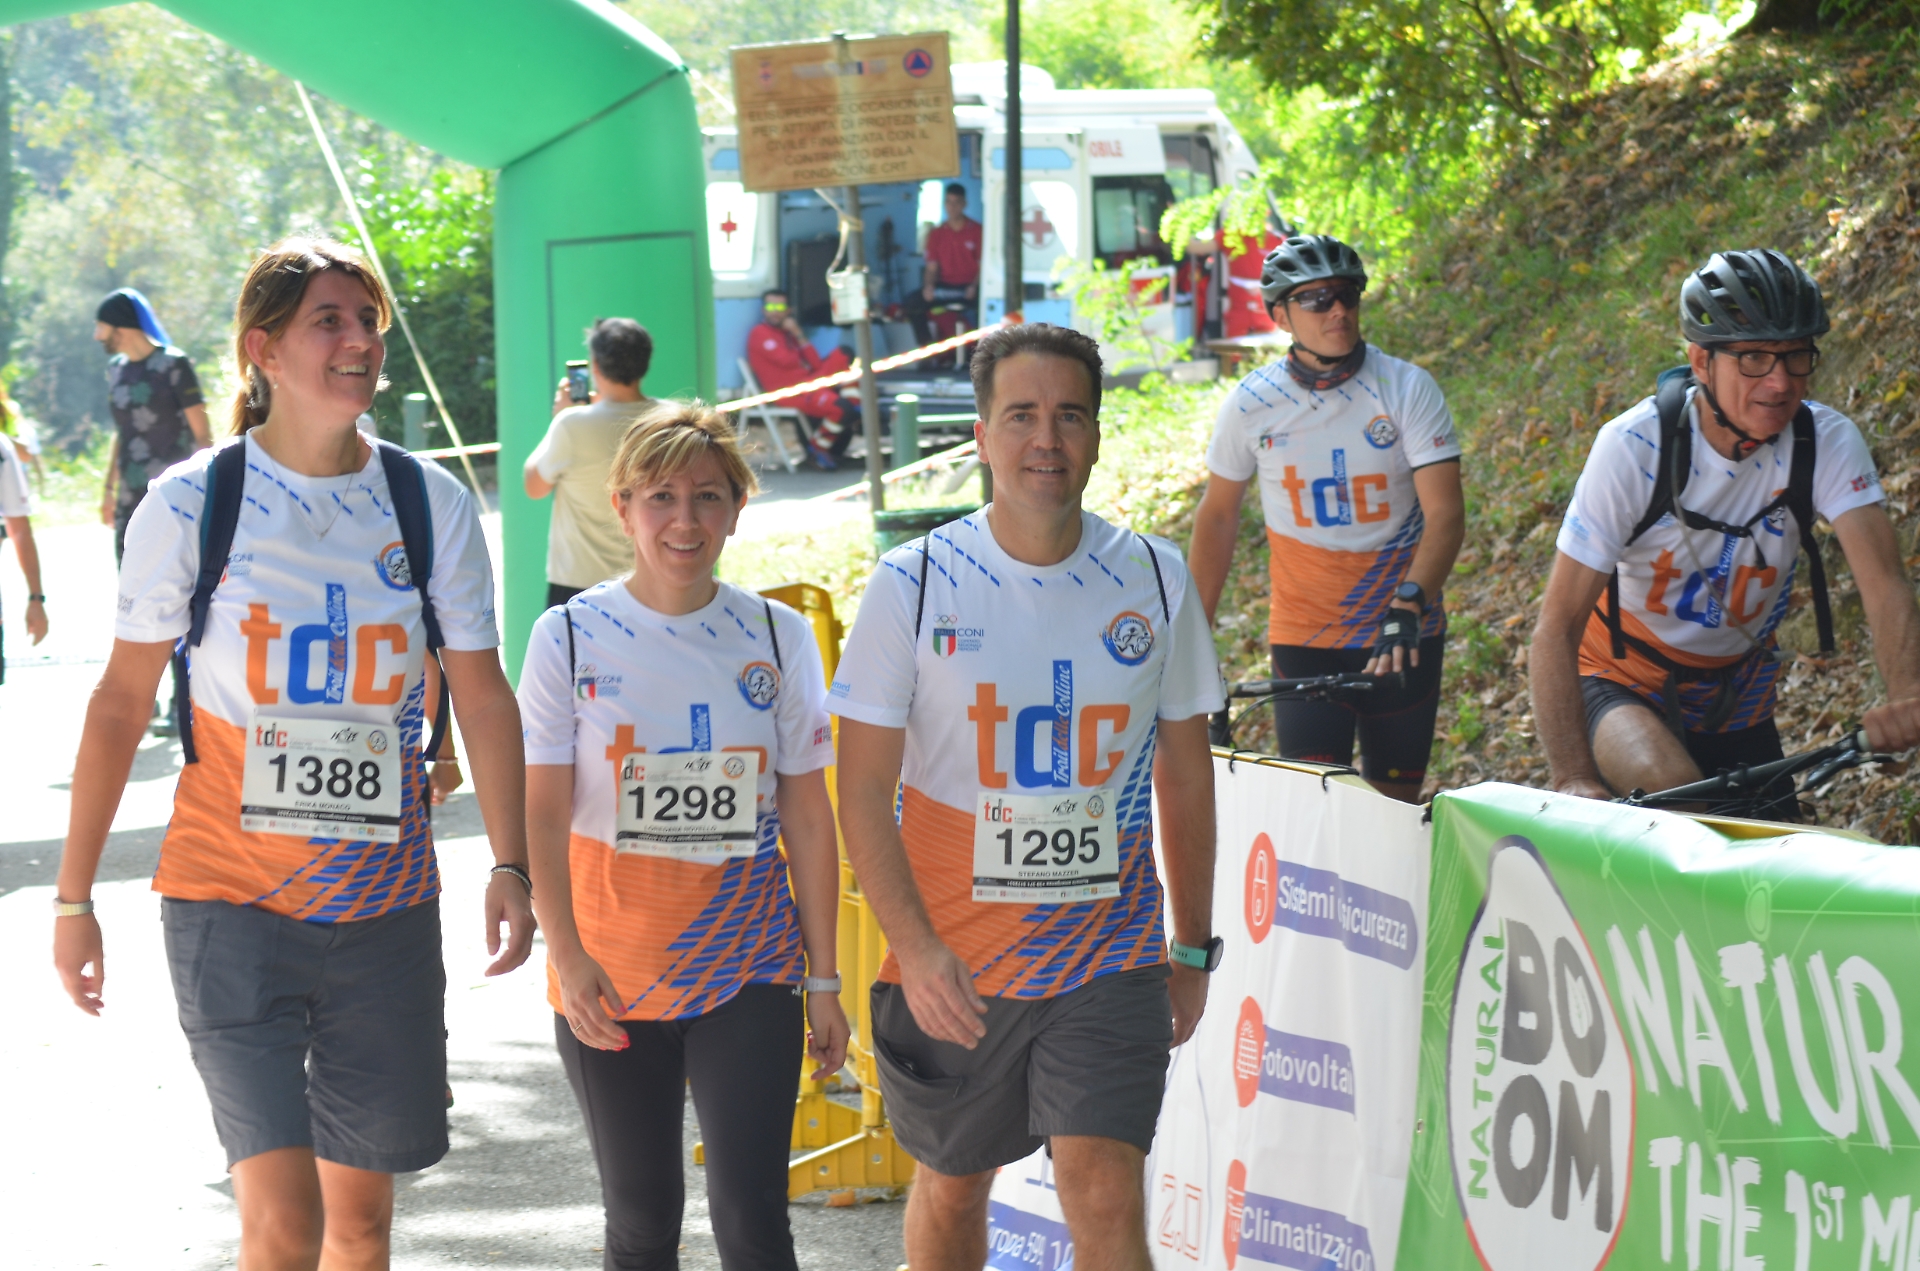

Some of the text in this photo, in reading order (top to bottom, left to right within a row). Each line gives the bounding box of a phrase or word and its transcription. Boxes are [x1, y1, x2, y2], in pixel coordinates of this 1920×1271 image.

[849, 95, 943, 116] OCCASIONALE
[751, 123, 778, 138] PER
[840, 118, 856, 130] DI
[858, 111, 943, 128] PROTEZIONE
[766, 128, 930, 152] CIVILE FINANZIATA CON IL
[784, 145, 914, 166] CONTRIBUTO DELLA
[793, 161, 908, 181] FONDAZIONE CRT
[1281, 448, 1391, 528] tdc
[239, 582, 409, 706] tdc
[957, 628, 984, 637] CONI
[256, 722, 288, 749] tdc
[967, 660, 1131, 789] tdc
[268, 753, 382, 801] 1388
[627, 785, 737, 822] 1298
[983, 798, 1013, 824] tdc
[996, 825, 1101, 867] 1295
[1052, 870, 1079, 878] MAZZER
[1605, 924, 1920, 1154] NATUR
[1467, 917, 1506, 1200] NATURAL
[1648, 1136, 1767, 1271] THE
